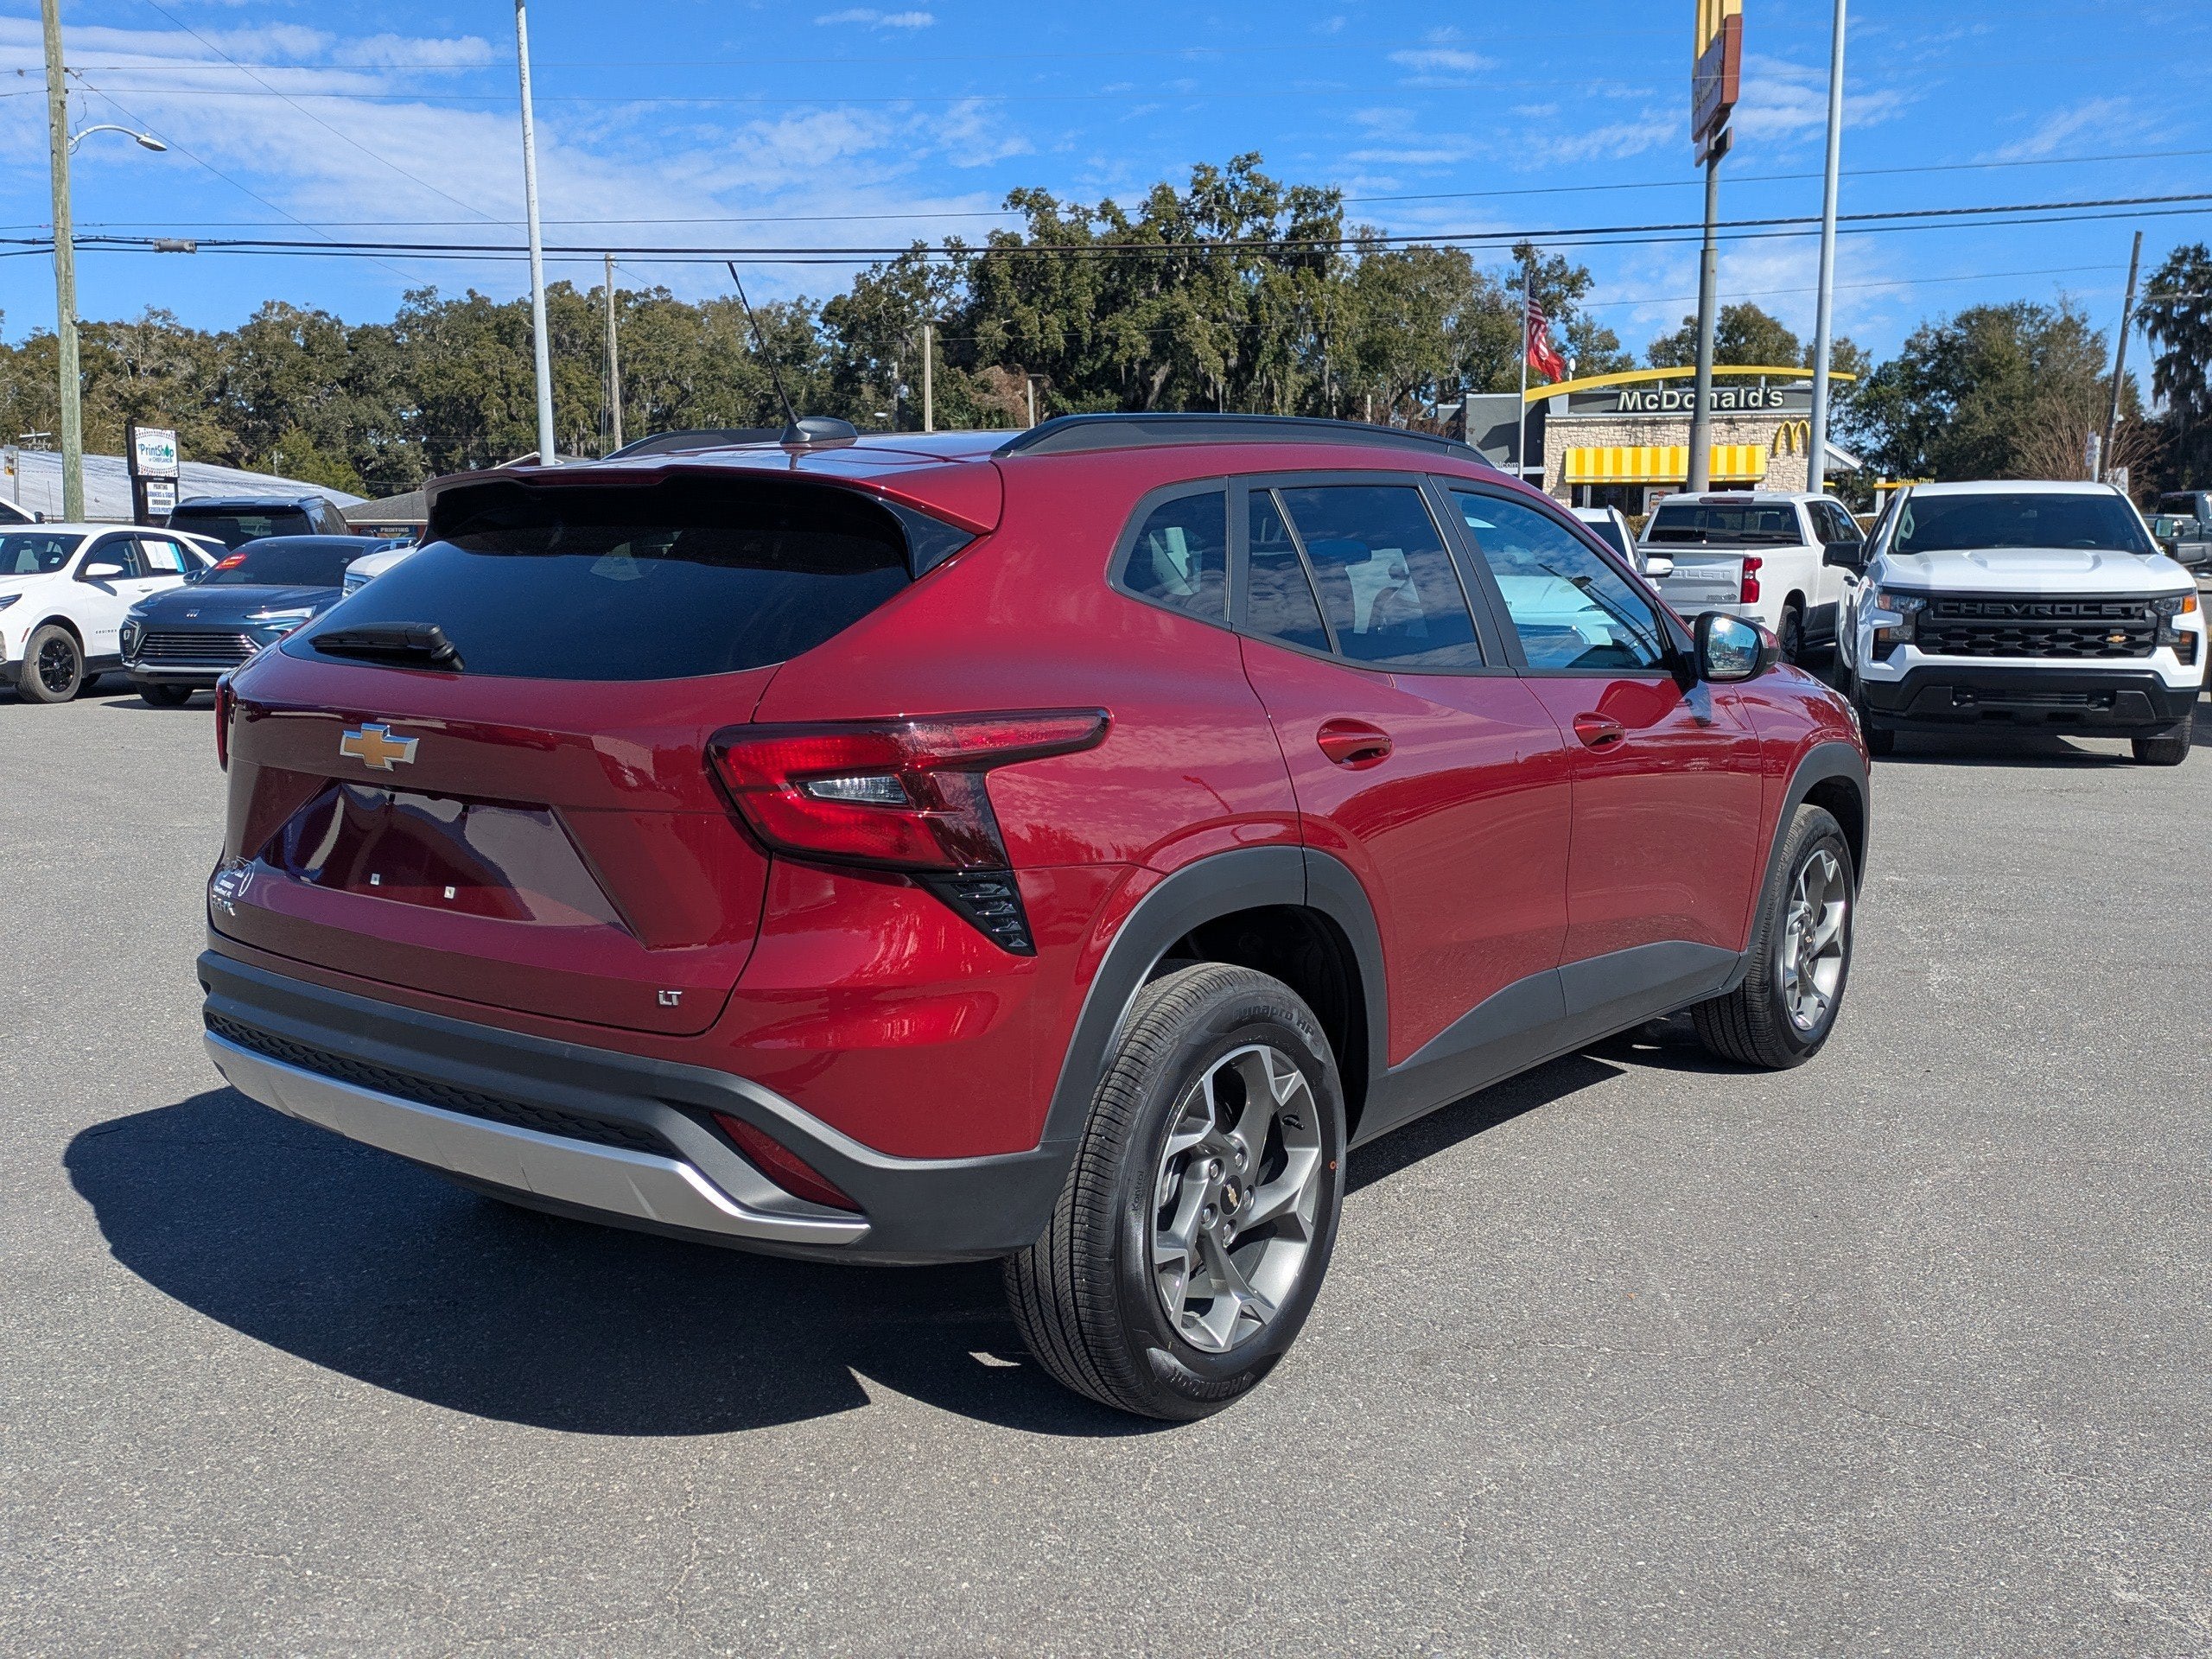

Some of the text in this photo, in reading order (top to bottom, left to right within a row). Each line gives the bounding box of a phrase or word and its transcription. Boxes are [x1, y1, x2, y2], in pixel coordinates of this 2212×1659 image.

[1617, 388, 1784, 411] McDonald's
[1937, 602, 2145, 616] CHEVROLET
[658, 990, 683, 1006] LT
